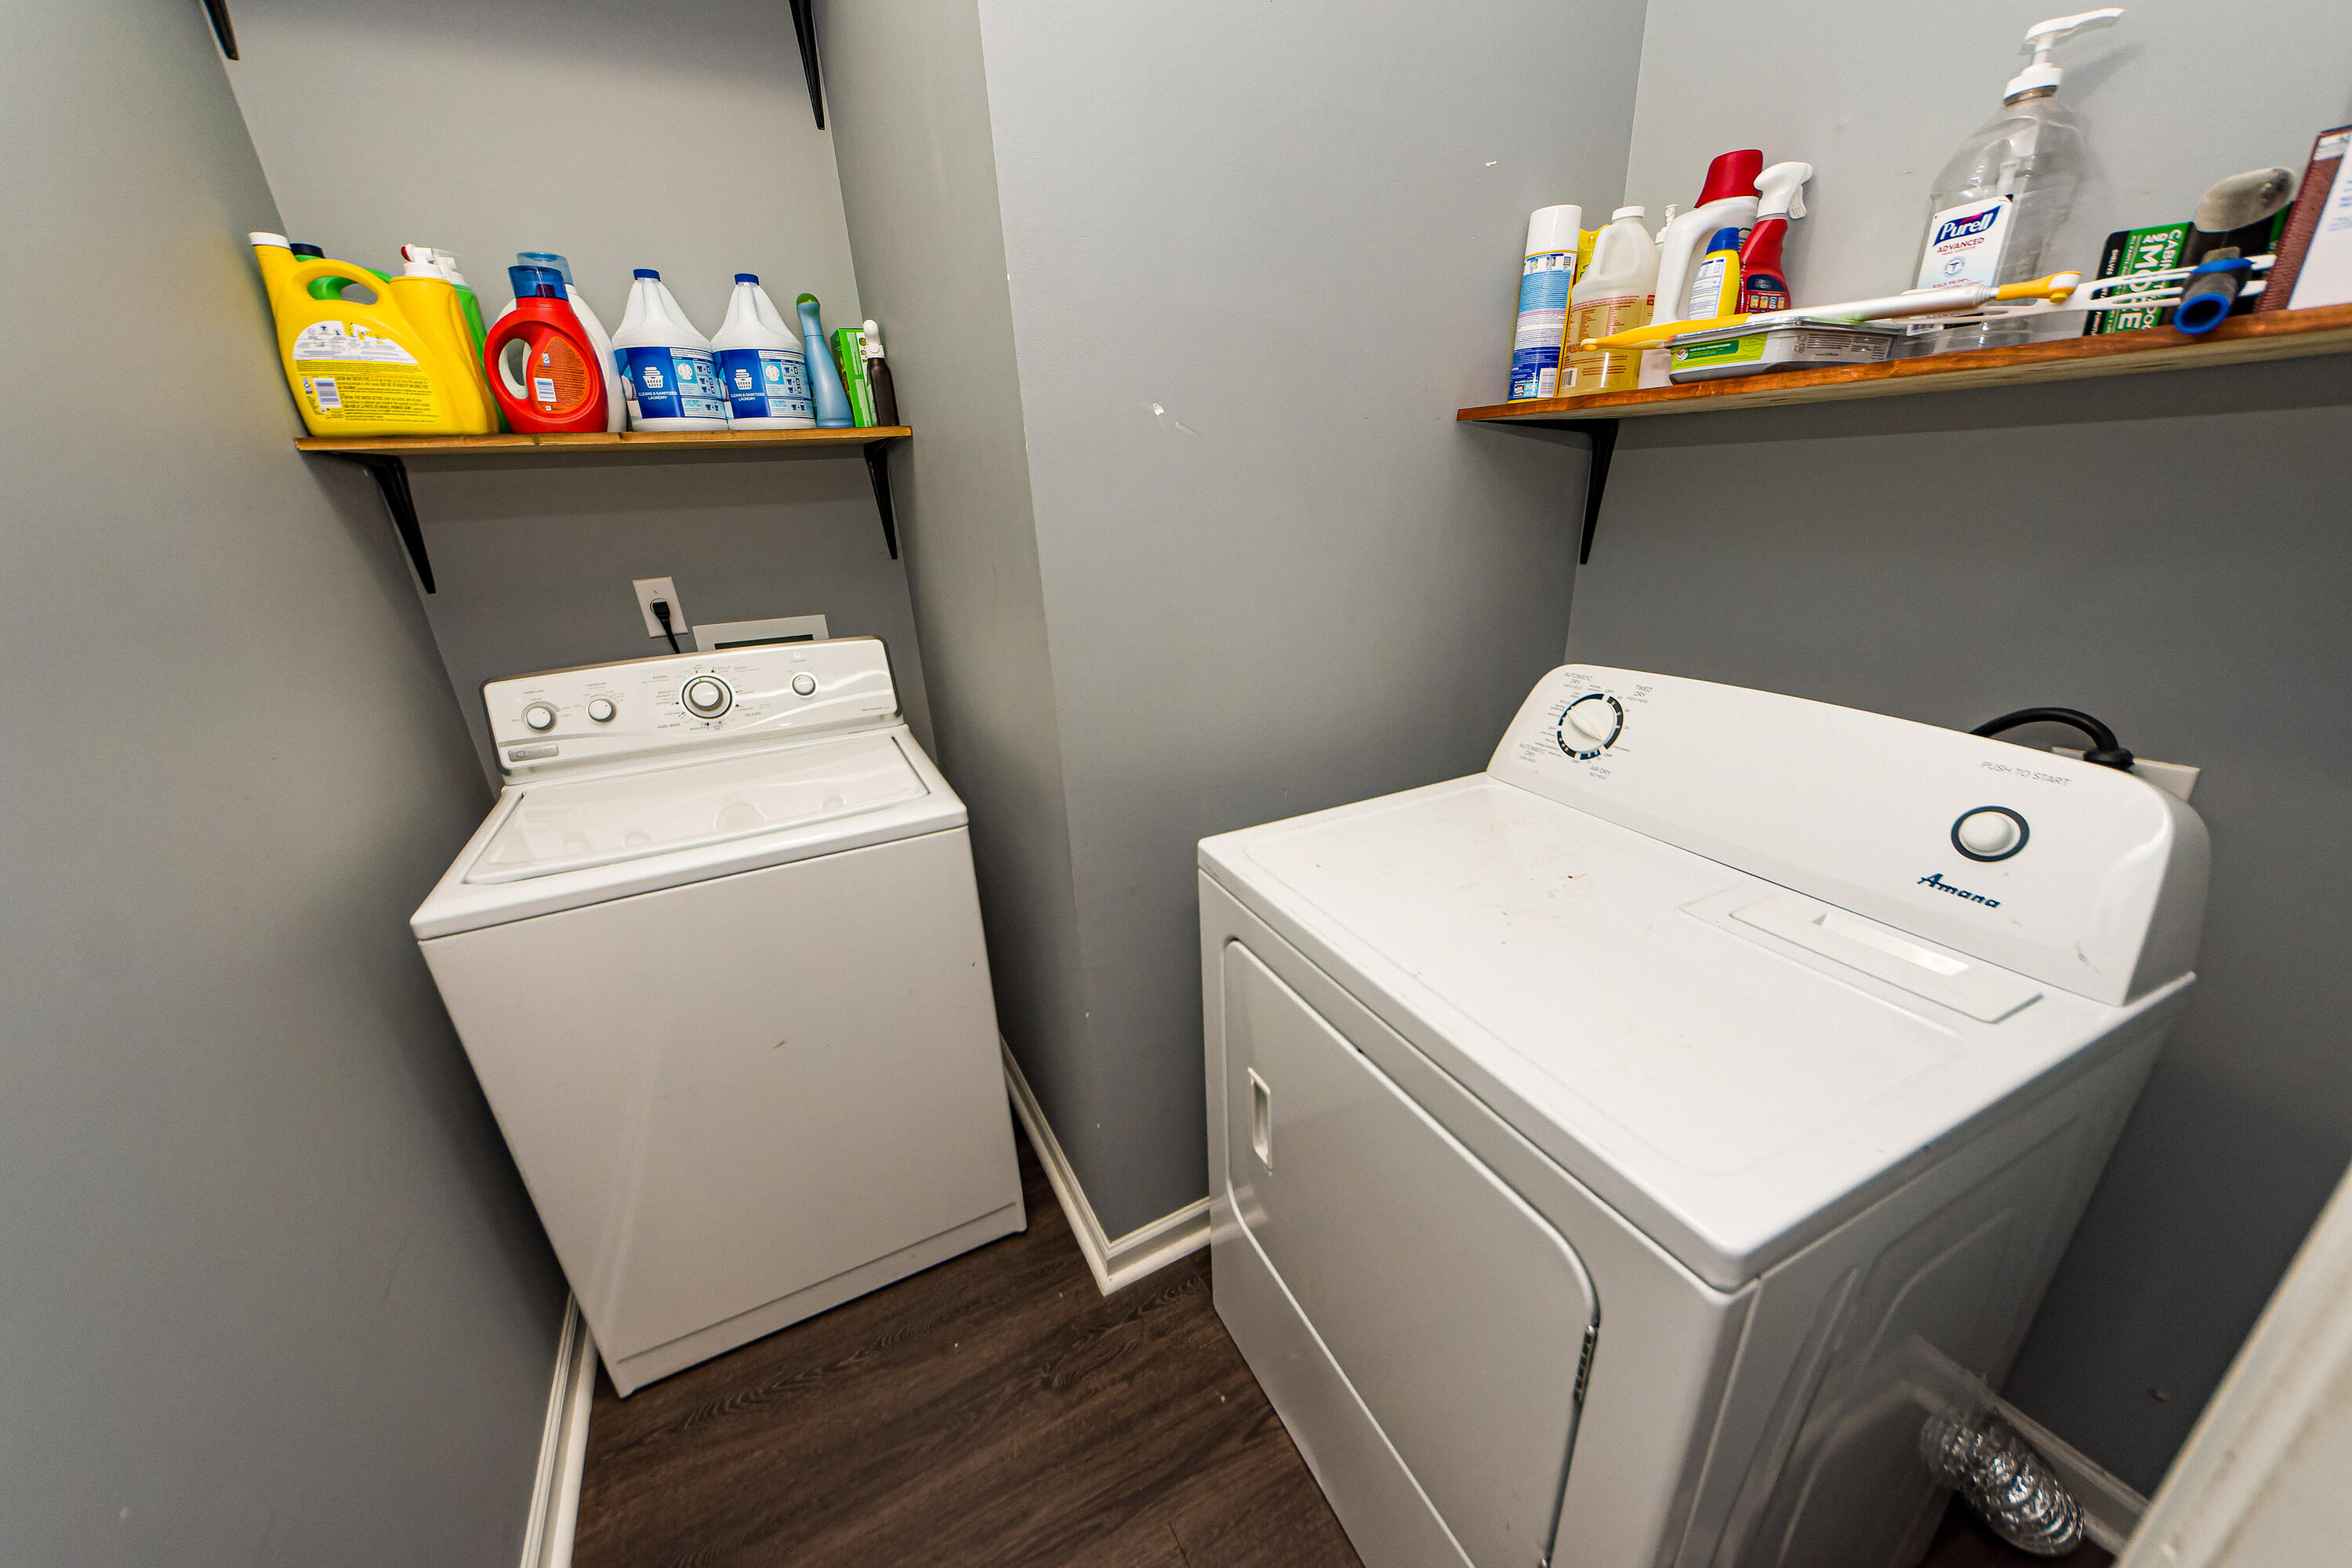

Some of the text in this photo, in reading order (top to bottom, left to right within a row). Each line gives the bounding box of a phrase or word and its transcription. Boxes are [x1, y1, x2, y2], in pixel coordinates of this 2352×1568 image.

[1940, 212, 1994, 240] Purell
[1937, 238, 1985, 253] ADVANCED
[2154, 229, 2183, 289] CABINT
[1981, 760, 2071, 786] PUSH TO START
[1917, 873, 2002, 909] Amana
